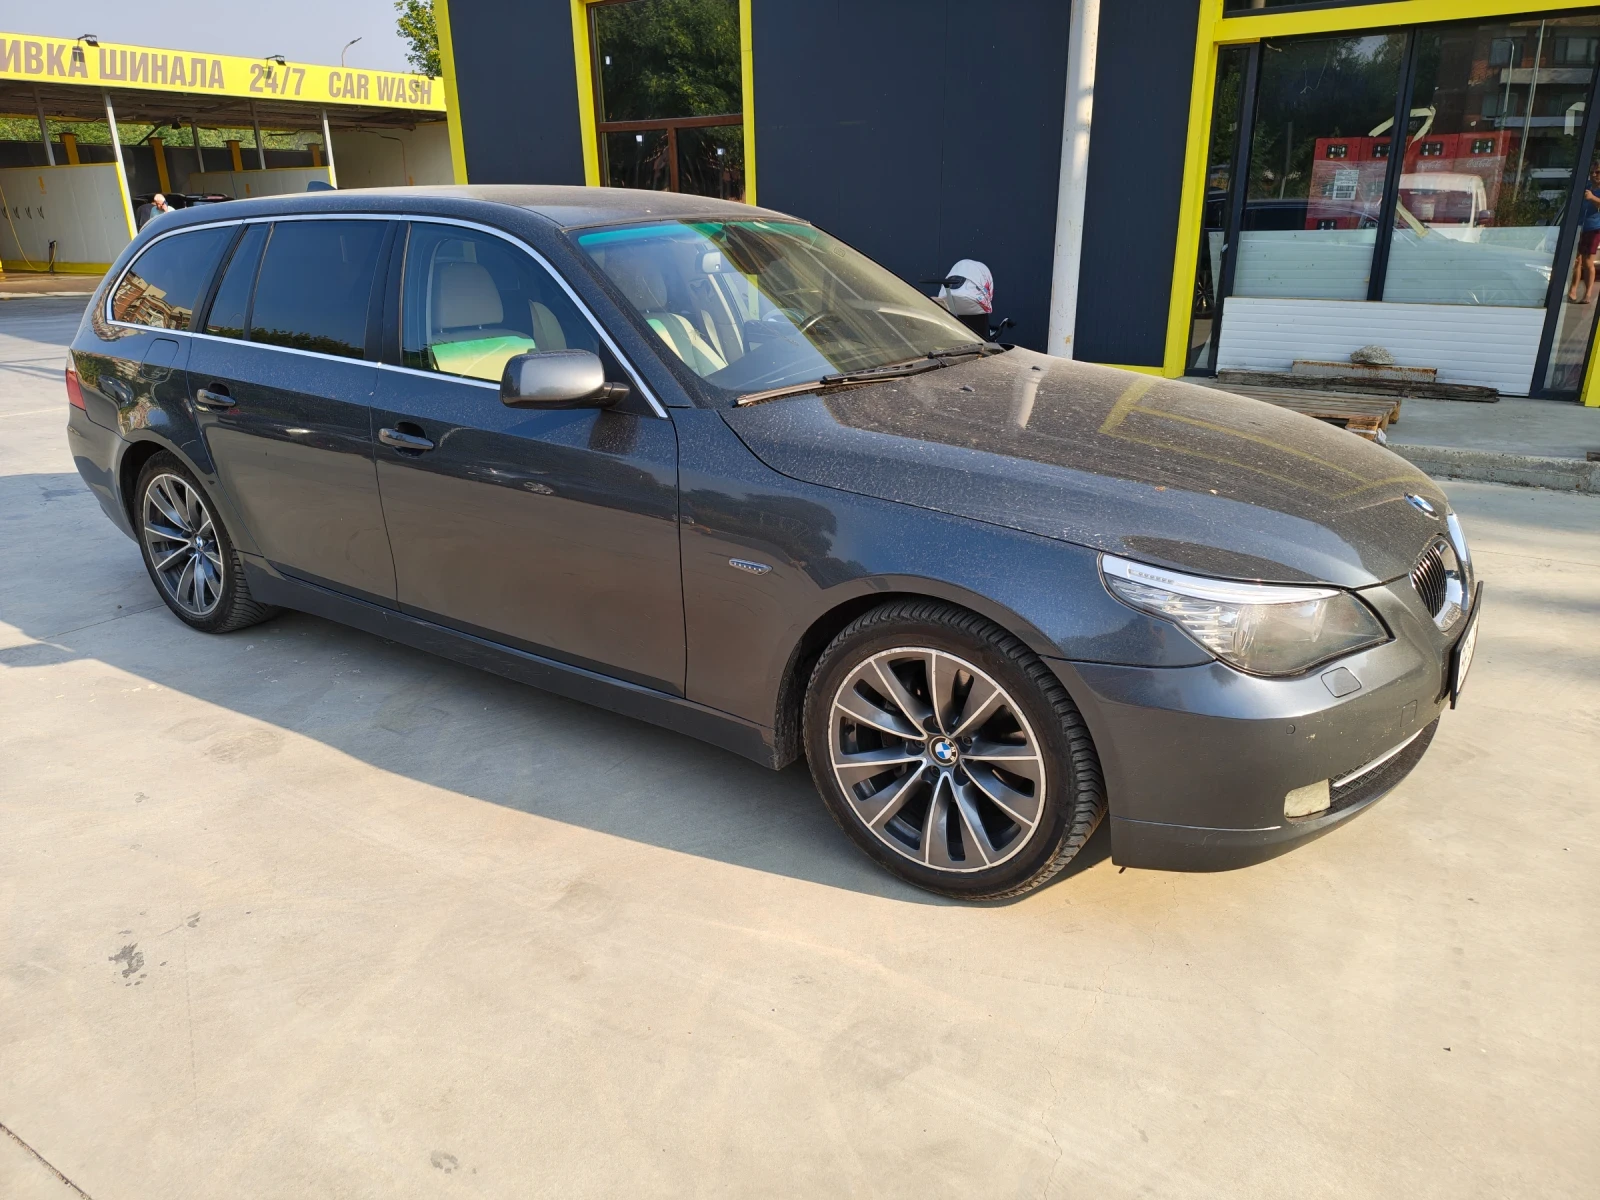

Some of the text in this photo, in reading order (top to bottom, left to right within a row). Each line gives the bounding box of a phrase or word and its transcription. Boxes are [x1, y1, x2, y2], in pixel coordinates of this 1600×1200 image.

[99, 48, 225, 89] ШИНАЛА
[249, 64, 432, 105] 24/7 CAR WASH
